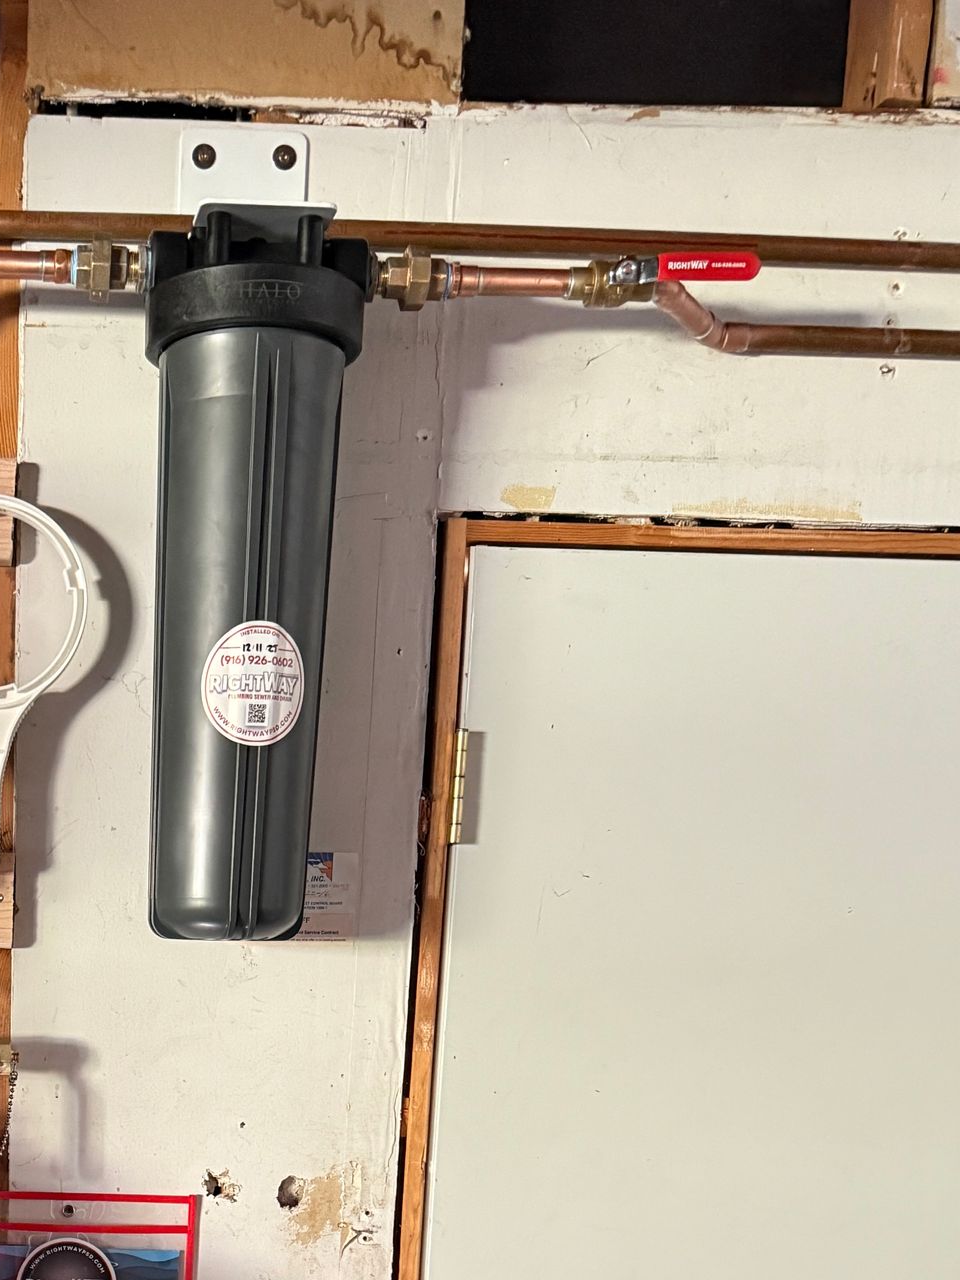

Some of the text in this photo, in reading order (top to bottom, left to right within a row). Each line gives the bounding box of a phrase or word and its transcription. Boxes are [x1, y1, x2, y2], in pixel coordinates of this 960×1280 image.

[668, 260, 710, 270] RIGHTWAY
[239, 280, 301, 300] HALO
[240, 629, 271, 638] INSTALLED
[220, 654, 294, 668] (916) 926-0602
[209, 671, 299, 696] RIGHTWAY
[30, 1245, 105, 1274] WWW.RIGHTWAYPSD.COM
